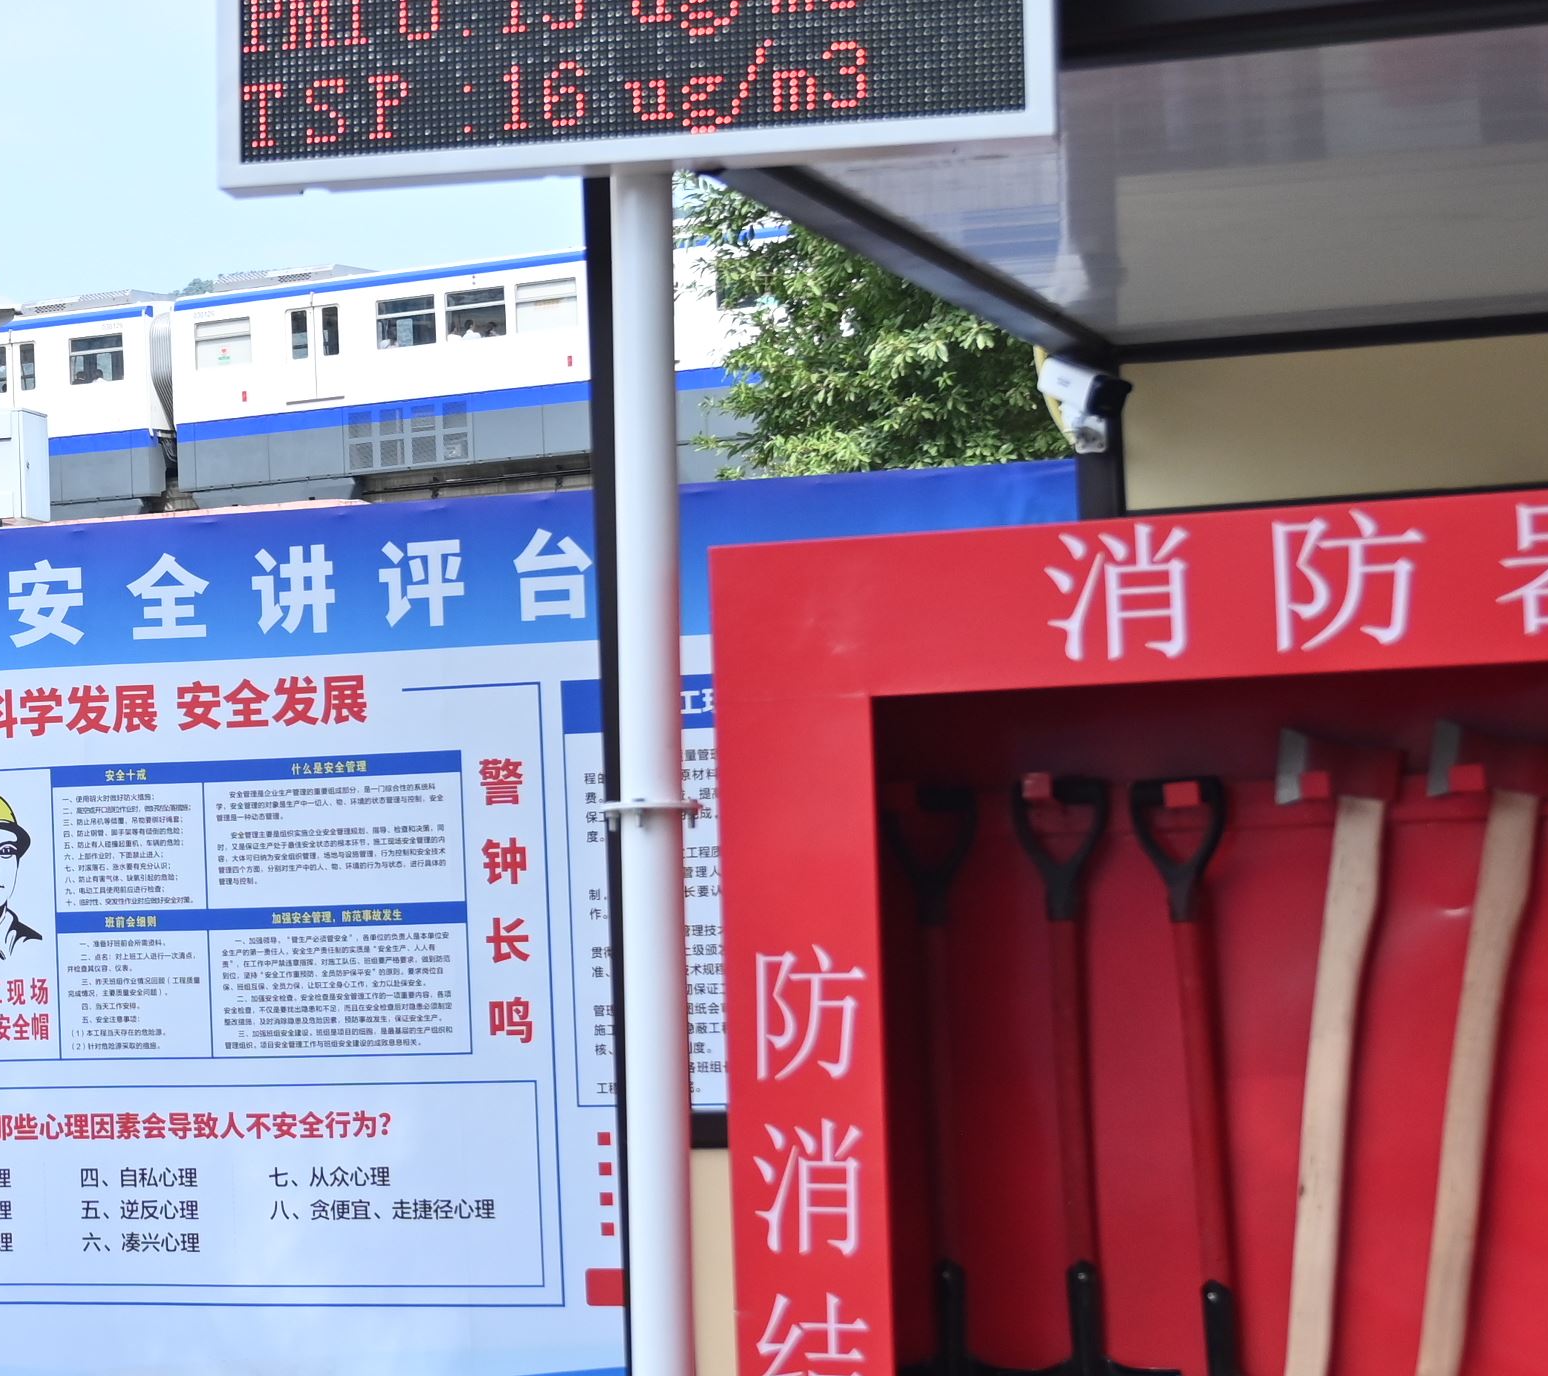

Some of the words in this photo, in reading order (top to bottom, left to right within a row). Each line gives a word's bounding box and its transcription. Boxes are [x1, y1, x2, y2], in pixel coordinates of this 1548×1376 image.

[622, 38, 868, 135] ug/m3
[177, 673, 367, 730] 安全发展
[105, 768, 147, 782] 安全十戒
[291, 760, 368, 775] 什么是安全管理
[479, 758, 534, 1045] 警钟长鸣
[105, 915, 157, 928] 班前会细则
[271, 908, 403, 924] 加强安全管理，防范事故发生
[80, 1167, 198, 1189] 四、自私心理
[269, 1166, 391, 1188] 七、从众心理
[81, 1199, 199, 1222] 五、逆反心理
[270, 1198, 496, 1222] 八、贪便宜、走捷径心理
[82, 1231, 201, 1254] 六、凑兴心理
